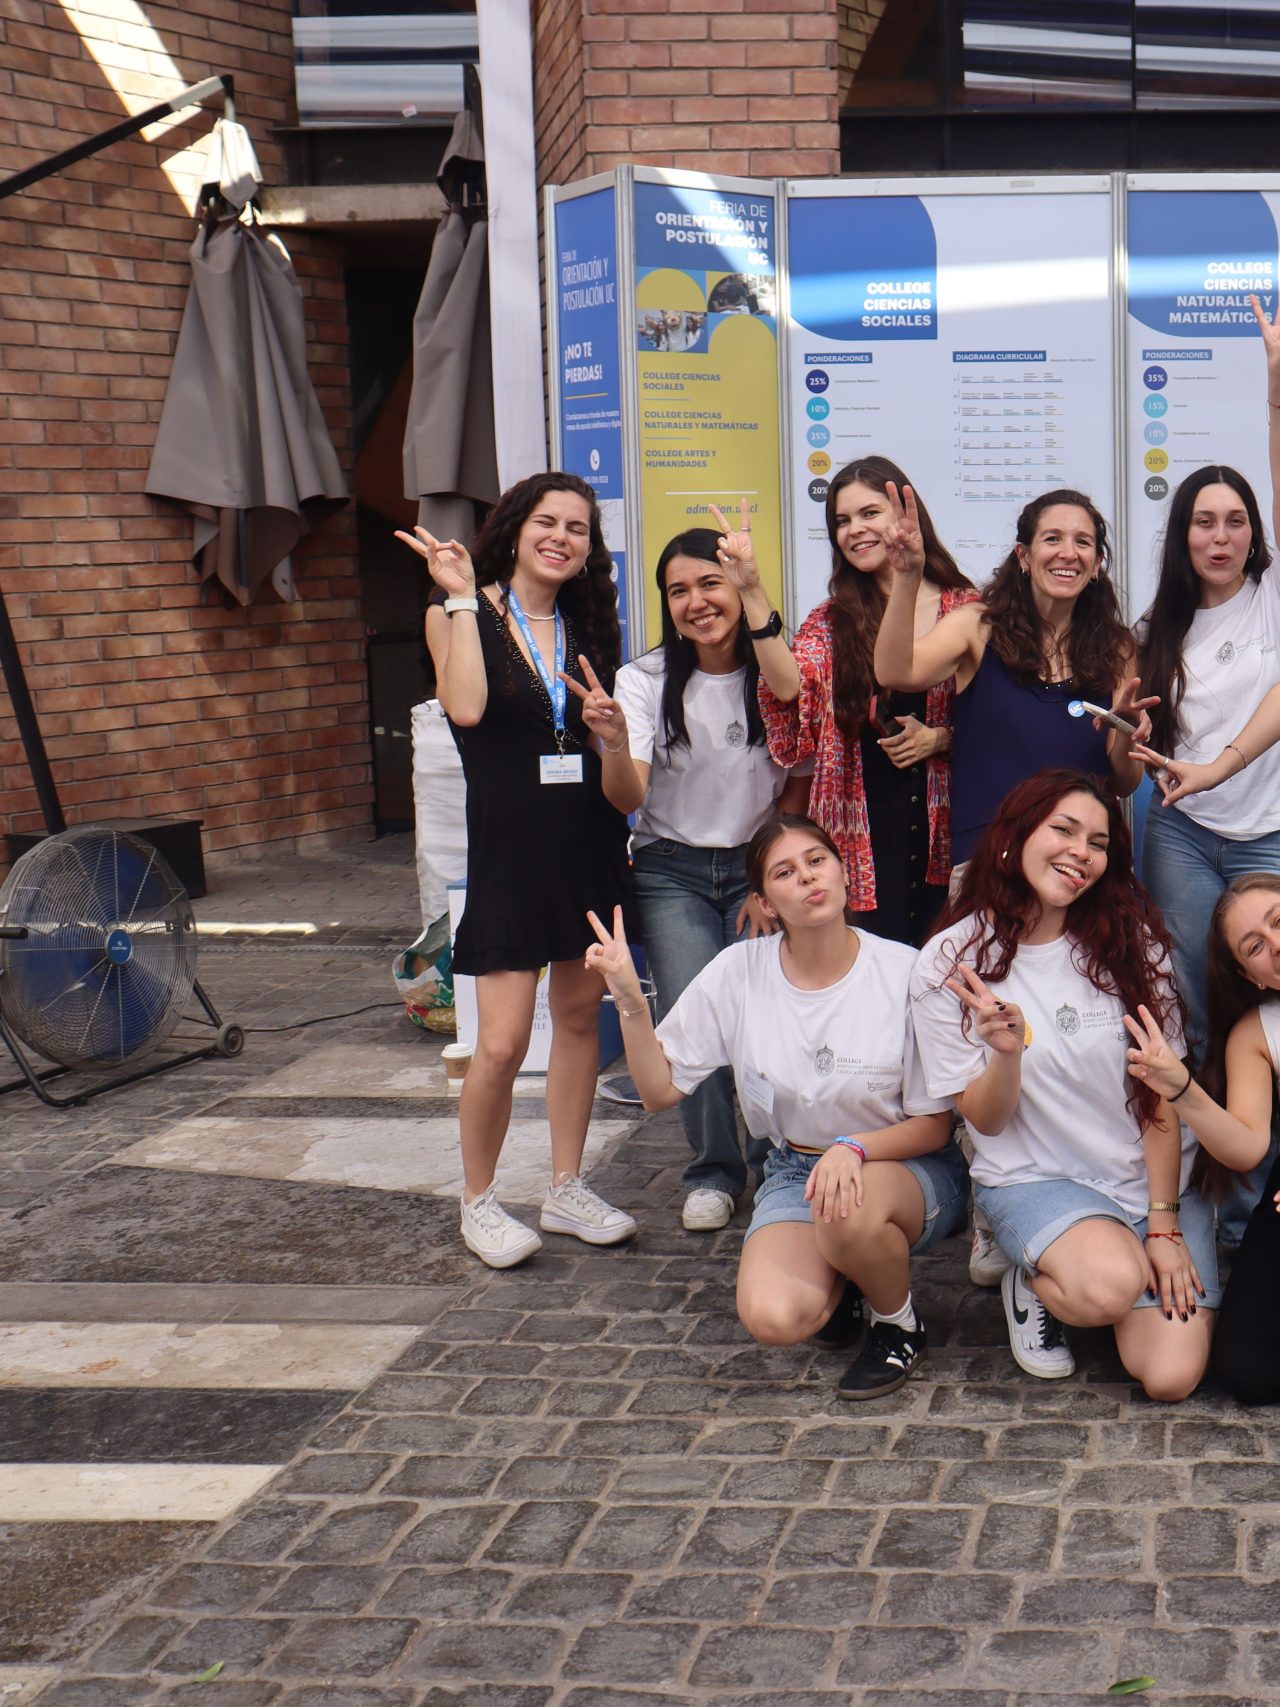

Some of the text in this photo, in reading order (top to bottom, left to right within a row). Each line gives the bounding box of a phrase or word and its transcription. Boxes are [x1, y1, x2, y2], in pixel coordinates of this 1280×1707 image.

[709, 199, 768, 218] FERIA DE
[655, 211, 768, 234] ORIENTACIÓN Y
[666, 228, 768, 250] POSTULACIÓN
[748, 252, 769, 267] UC
[562, 256, 608, 286] ORIENTACIÓN Y
[1207, 262, 1272, 274] COLLEGE
[866, 282, 932, 294] COLLEGE
[1204, 278, 1272, 290] CIENCIAS
[563, 282, 614, 312] POSTULACIÓN UC
[1264, 296, 1272, 306] Y
[864, 298, 932, 311] CIENCIAS
[862, 314, 932, 327] SOCIALES
[1169, 310, 1272, 324] MATEMÁTICS
[564, 342, 592, 365] ¡NO TE
[807, 354, 870, 363] PONDERACIONES
[565, 364, 603, 384] PIERDAS!
[642, 372, 720, 382] COLLEGE CIENCIAS
[1148, 374, 1164, 382] 35%
[643, 382, 684, 390] SOCIALES
[809, 377, 826, 386] 25%
[810, 404, 827, 412] 10%
[644, 411, 722, 420] COLLEGE CIENCIAS
[644, 422, 694, 430] NATURALES
[701, 421, 759, 430] MATEMÁTICAS
[810, 432, 827, 440] 25%
[646, 450, 684, 458] COLLEGE
[646, 460, 708, 468] HUMANIDADES
[1148, 456, 1165, 464] 20%
[812, 486, 828, 494] 20%
[1148, 484, 1166, 492] 20%
